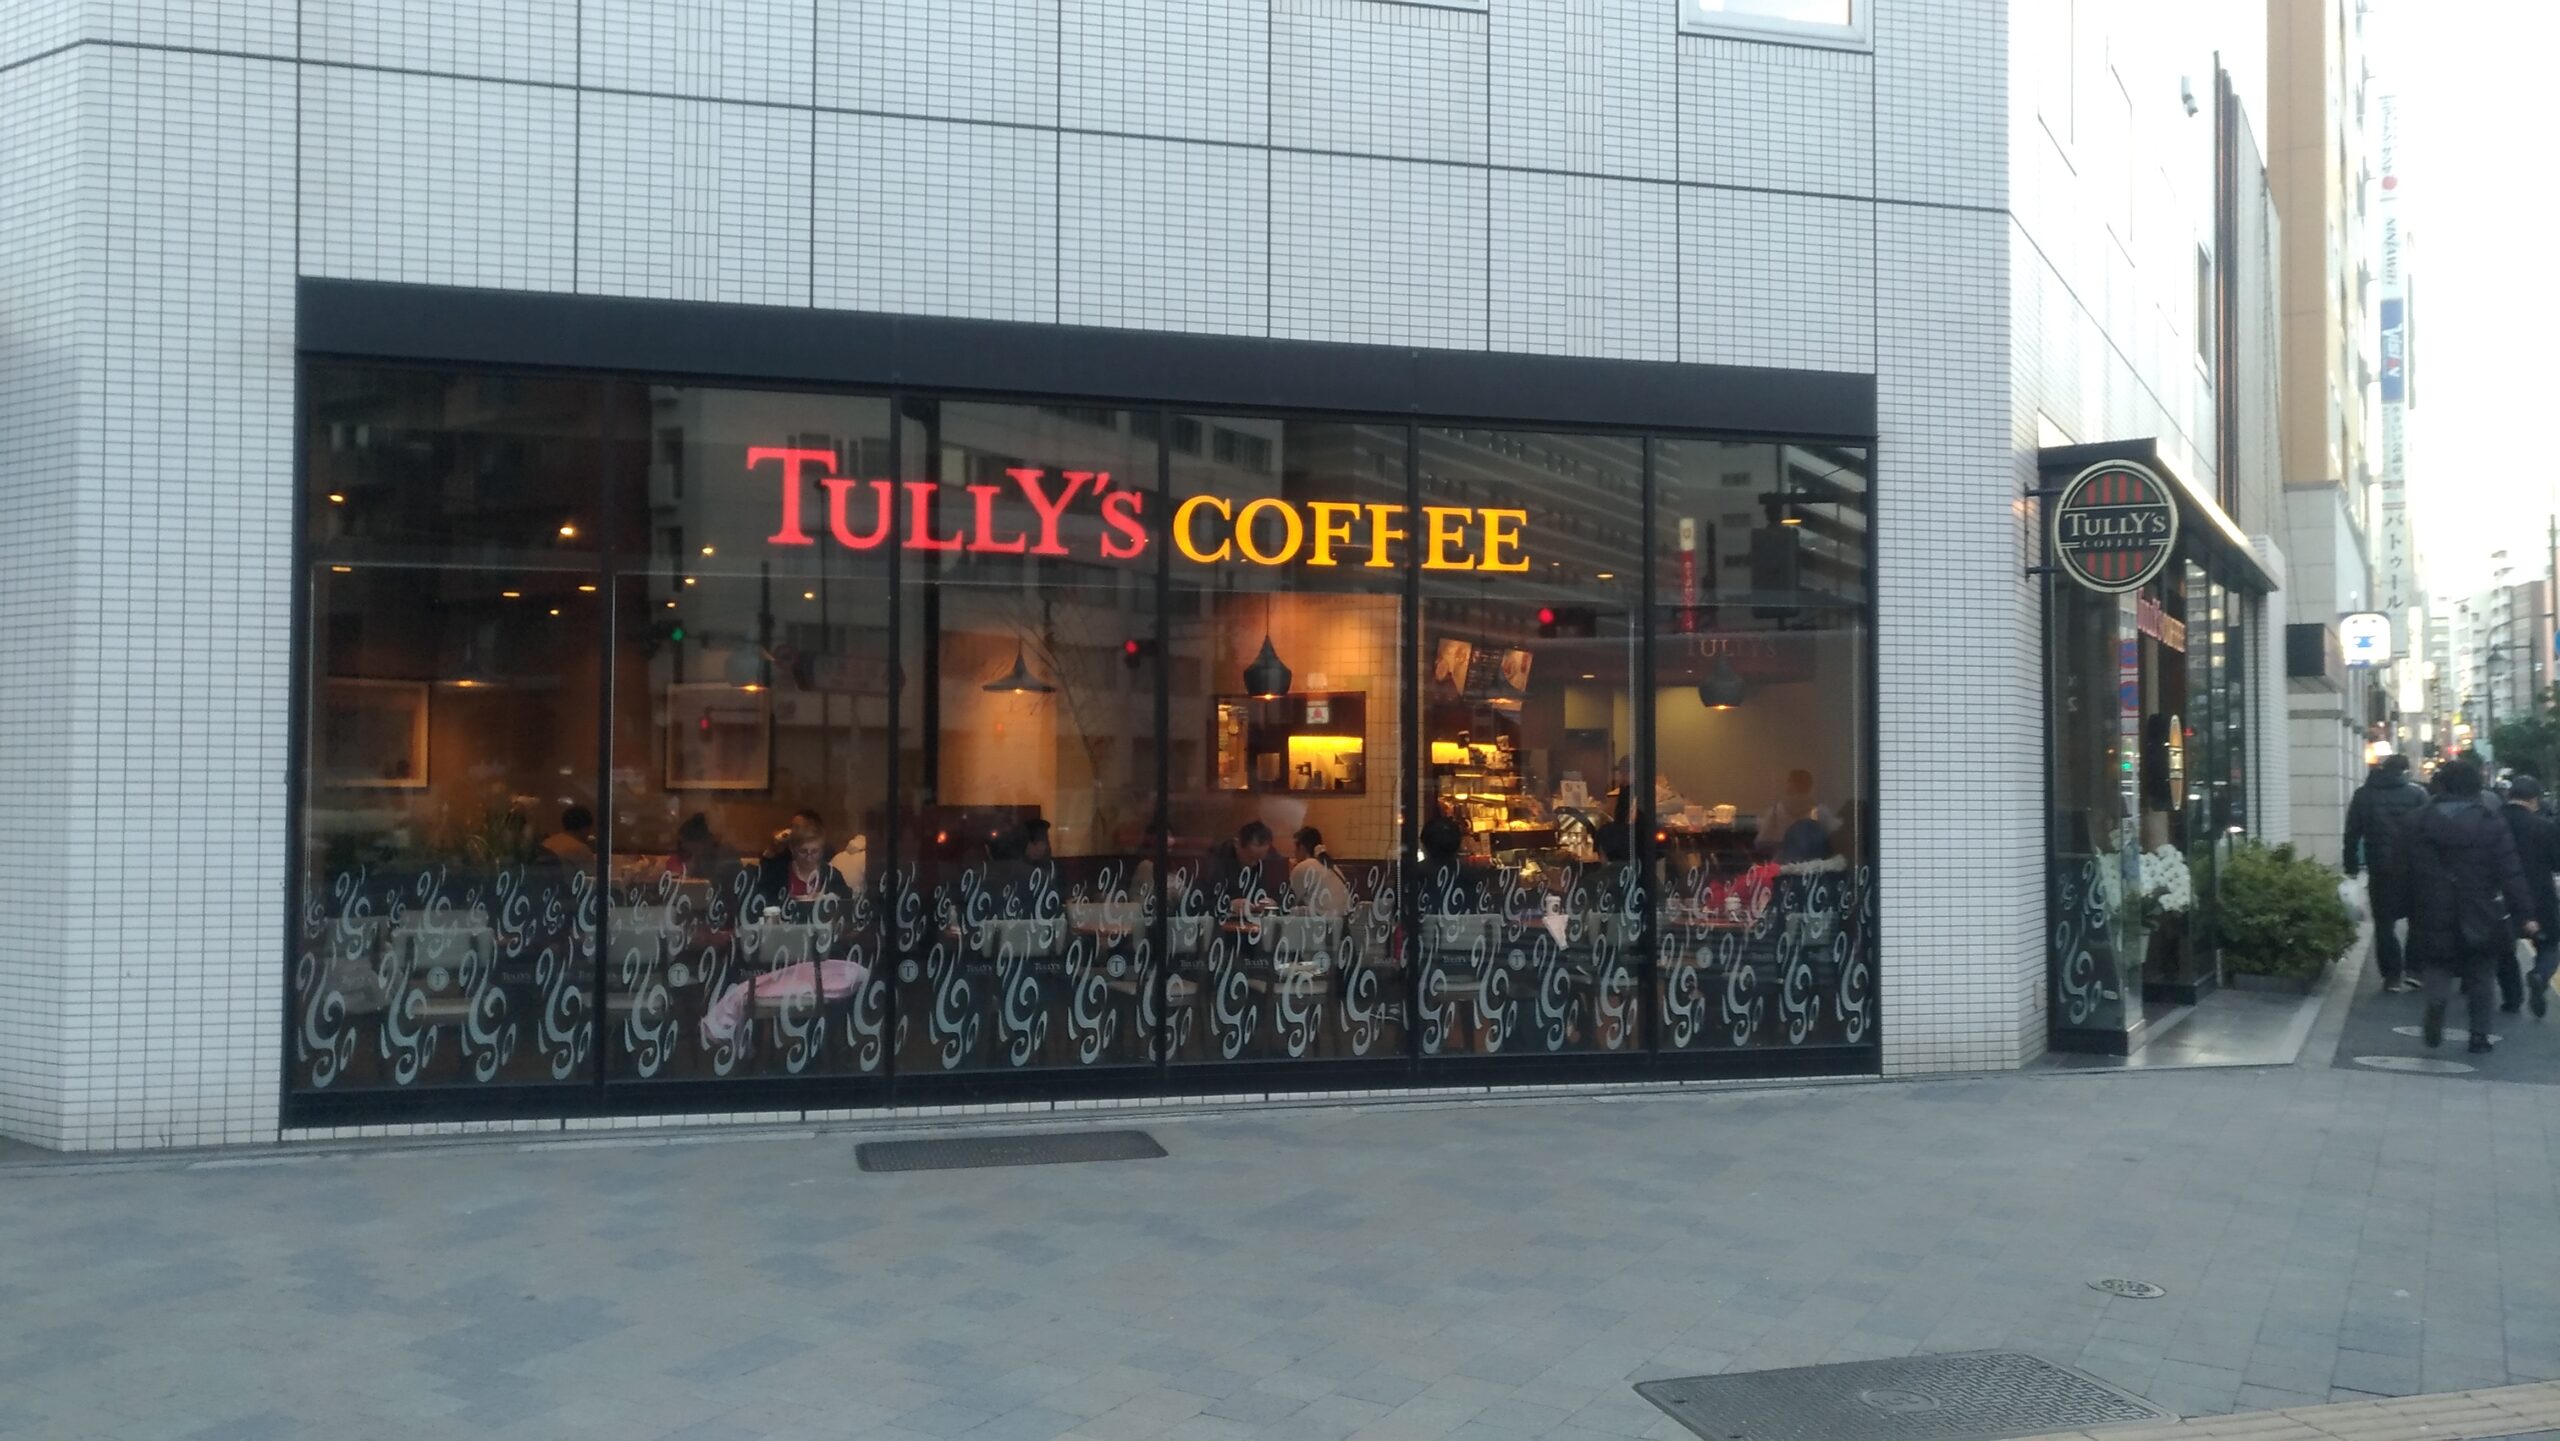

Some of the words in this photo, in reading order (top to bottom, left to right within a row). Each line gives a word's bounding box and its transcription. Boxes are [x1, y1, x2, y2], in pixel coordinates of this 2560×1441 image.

[746, 446, 1147, 559] TULLY'S
[1173, 495, 1529, 572] COFFEE
[2065, 512, 2166, 536] TULLY'S
